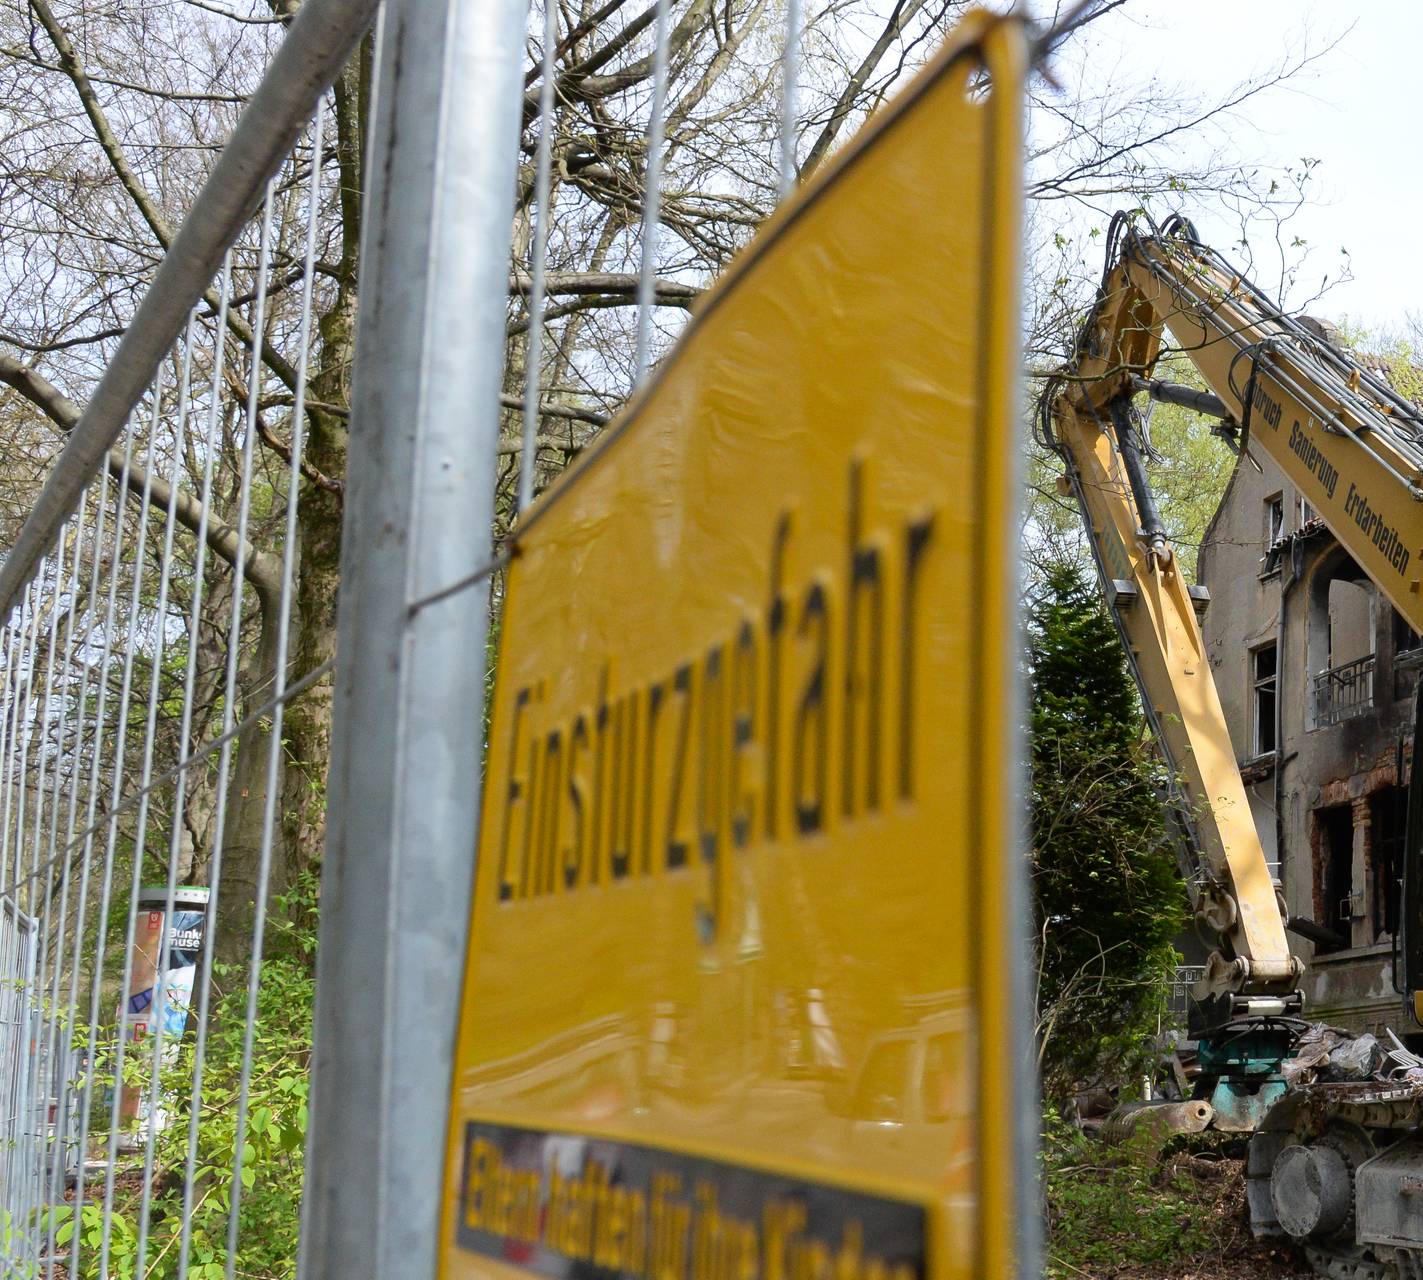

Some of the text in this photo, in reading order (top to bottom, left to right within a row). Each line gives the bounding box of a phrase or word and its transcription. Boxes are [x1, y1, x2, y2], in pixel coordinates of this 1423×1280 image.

[1244, 381, 1410, 576] bruch Sanierung Erdarbeiten
[497, 458, 937, 944] Einsturzgefahr
[169, 928, 203, 939] Bunk
